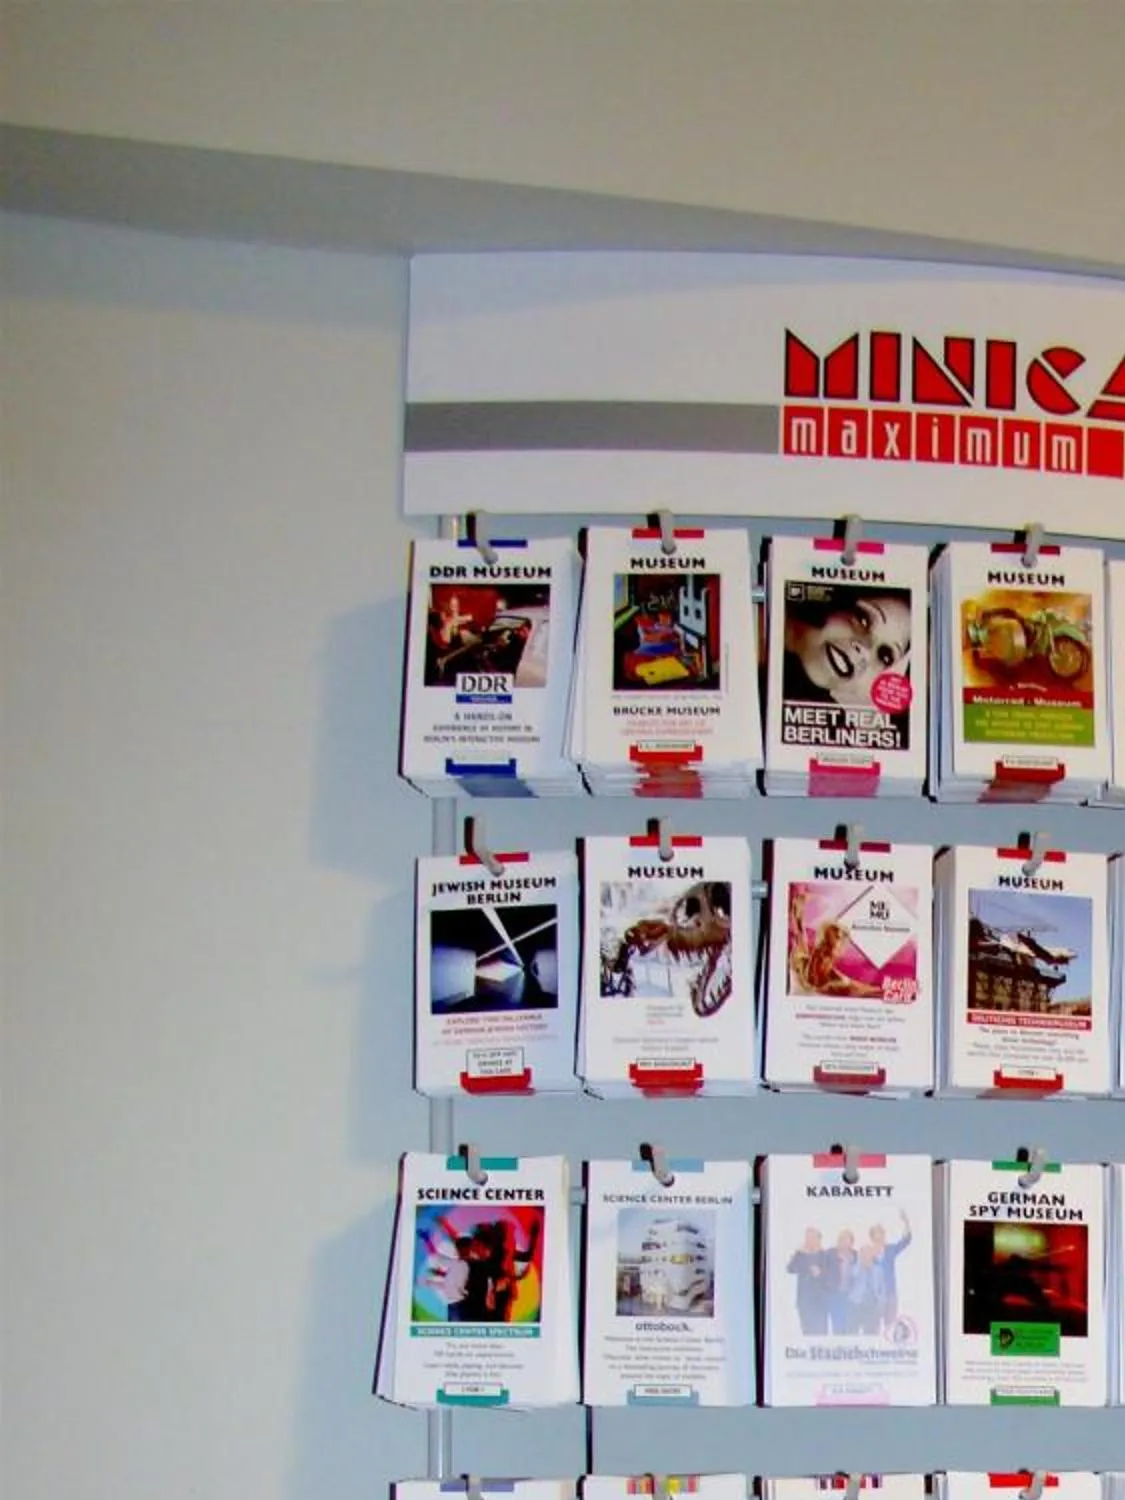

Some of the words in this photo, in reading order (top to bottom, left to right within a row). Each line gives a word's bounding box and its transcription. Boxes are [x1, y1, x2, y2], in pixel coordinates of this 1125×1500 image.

[790, 415, 1078, 474] maximum
[630, 557, 706, 570] MUSEUM
[429, 565, 468, 578] DDR
[474, 565, 552, 579] MUSEUM
[811, 566, 886, 582] MUSEUM
[987, 571, 1065, 587] MUSEUM
[460, 675, 510, 694] DDR
[666, 704, 721, 716] MUSEUM
[783, 707, 840, 726] MEET
[845, 709, 897, 729] REAL
[783, 727, 901, 748] BERLINERS!
[627, 867, 704, 878] MUSEUM
[813, 867, 895, 883] MUSEUM
[431, 880, 486, 897] JEWISH
[490, 878, 557, 890] MUSEUM
[998, 876, 1065, 891] MUSEUM
[467, 892, 521, 905] BERLIN
[417, 1189, 480, 1201] SCIENCE
[485, 1188, 545, 1200] CENTER
[806, 1186, 895, 1198] KABARETT
[987, 1191, 1065, 1206] GERMAN
[968, 1205, 1002, 1218] SPY
[1007, 1206, 1084, 1221] MUSEUM
